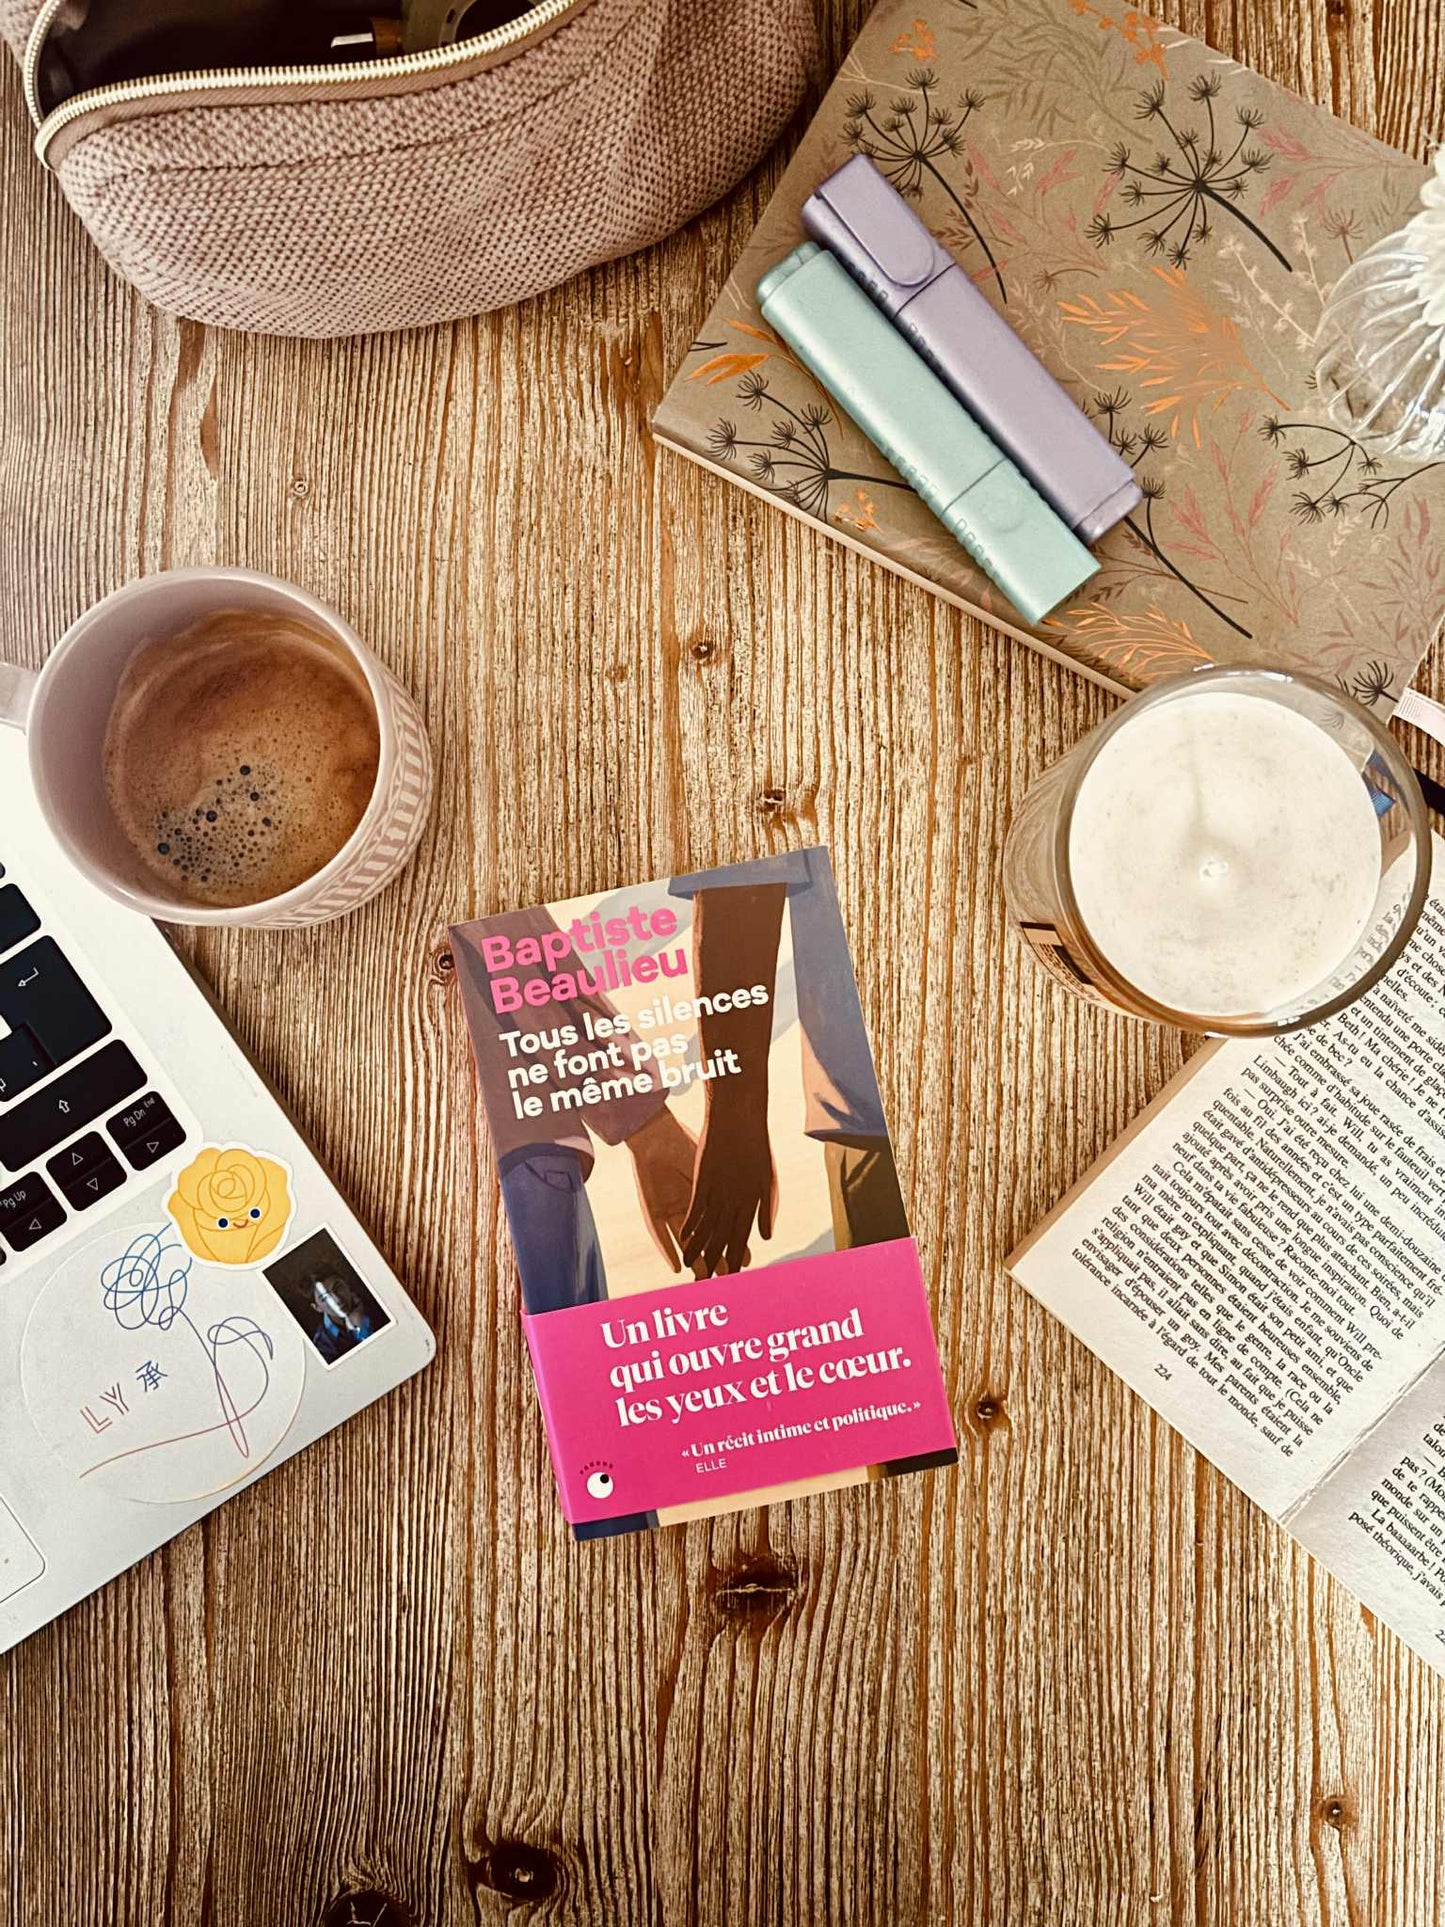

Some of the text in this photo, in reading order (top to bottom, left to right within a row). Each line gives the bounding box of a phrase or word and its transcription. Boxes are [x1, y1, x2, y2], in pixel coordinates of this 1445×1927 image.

[481, 906, 678, 973] Baptiste
[490, 948, 688, 1014] Beaulieu
[499, 982, 769, 1057] Tous les silences
[507, 1032, 689, 1089] ne font pas
[512, 1048, 742, 1120] le même bruit
[1292, 1032, 1437, 1168] J'ai embrassé sa joue rasée de frais
[1332, 1030, 1417, 1109] As-tu eu la chance
[123, 1116, 137, 1128] Pg
[133, 1108, 147, 1121] Dn
[1240, 1067, 1349, 1170] pas surprise outre mesure.
[1273, 1029, 1445, 1198] chée comme d'habitude sur le fauteuil vert
[3, 1190, 27, 1209] Pg Up
[1212, 1099, 1436, 1309] quentable. Naturellement, je n'avais pas conscience qu'il
[1222, 1087, 1443, 1296] fois au fil des années et c'est un type parfaitement fré-
[1172, 1160, 1383, 1360] Cela m'épatait sans cesse de voir comment Will pre-
[1181, 1131, 1404, 1341] ajouté après avoir pris une longue inspiration. Quoi de
[1111, 1205, 1334, 1416] des considérations telles que le genre, la race ou la
[1121, 1194, 1342, 1406] tant que deux personnes étaient heureuses ensemble,
[1141, 1173, 1364, 1383] ma mère m'expliquant, quand j'étais enfant, qu'Oncle
[601, 1303, 728, 1349] Un livre
[609, 1307, 864, 1393] qui ouvre grand
[1071, 1247, 1294, 1458] tolérance incarnée à l'égard de tout le monde, sauf de
[1081, 1238, 1304, 1448] envisager d'épouser un goy. Mes parents étaient la
[1091, 1227, 1314, 1437] s'appliquait pas, il allait sans dire, au fait que je puisse
[80, 1382, 130, 1434] LY
[615, 1345, 912, 1427] les yeux et le cœur.
[1153, 1363, 1173, 1382] 224
[695, 1458, 728, 1474] ELLE
[717, 1430, 755, 1453] récit
[756, 1422, 812, 1447] intime
[813, 1416, 830, 1432] et
[1347, 1511, 1414, 1576] posé théorique,
[1370, 1489, 1443, 1558] que puissent être
[1380, 1477, 1444, 1538] monde sur un
